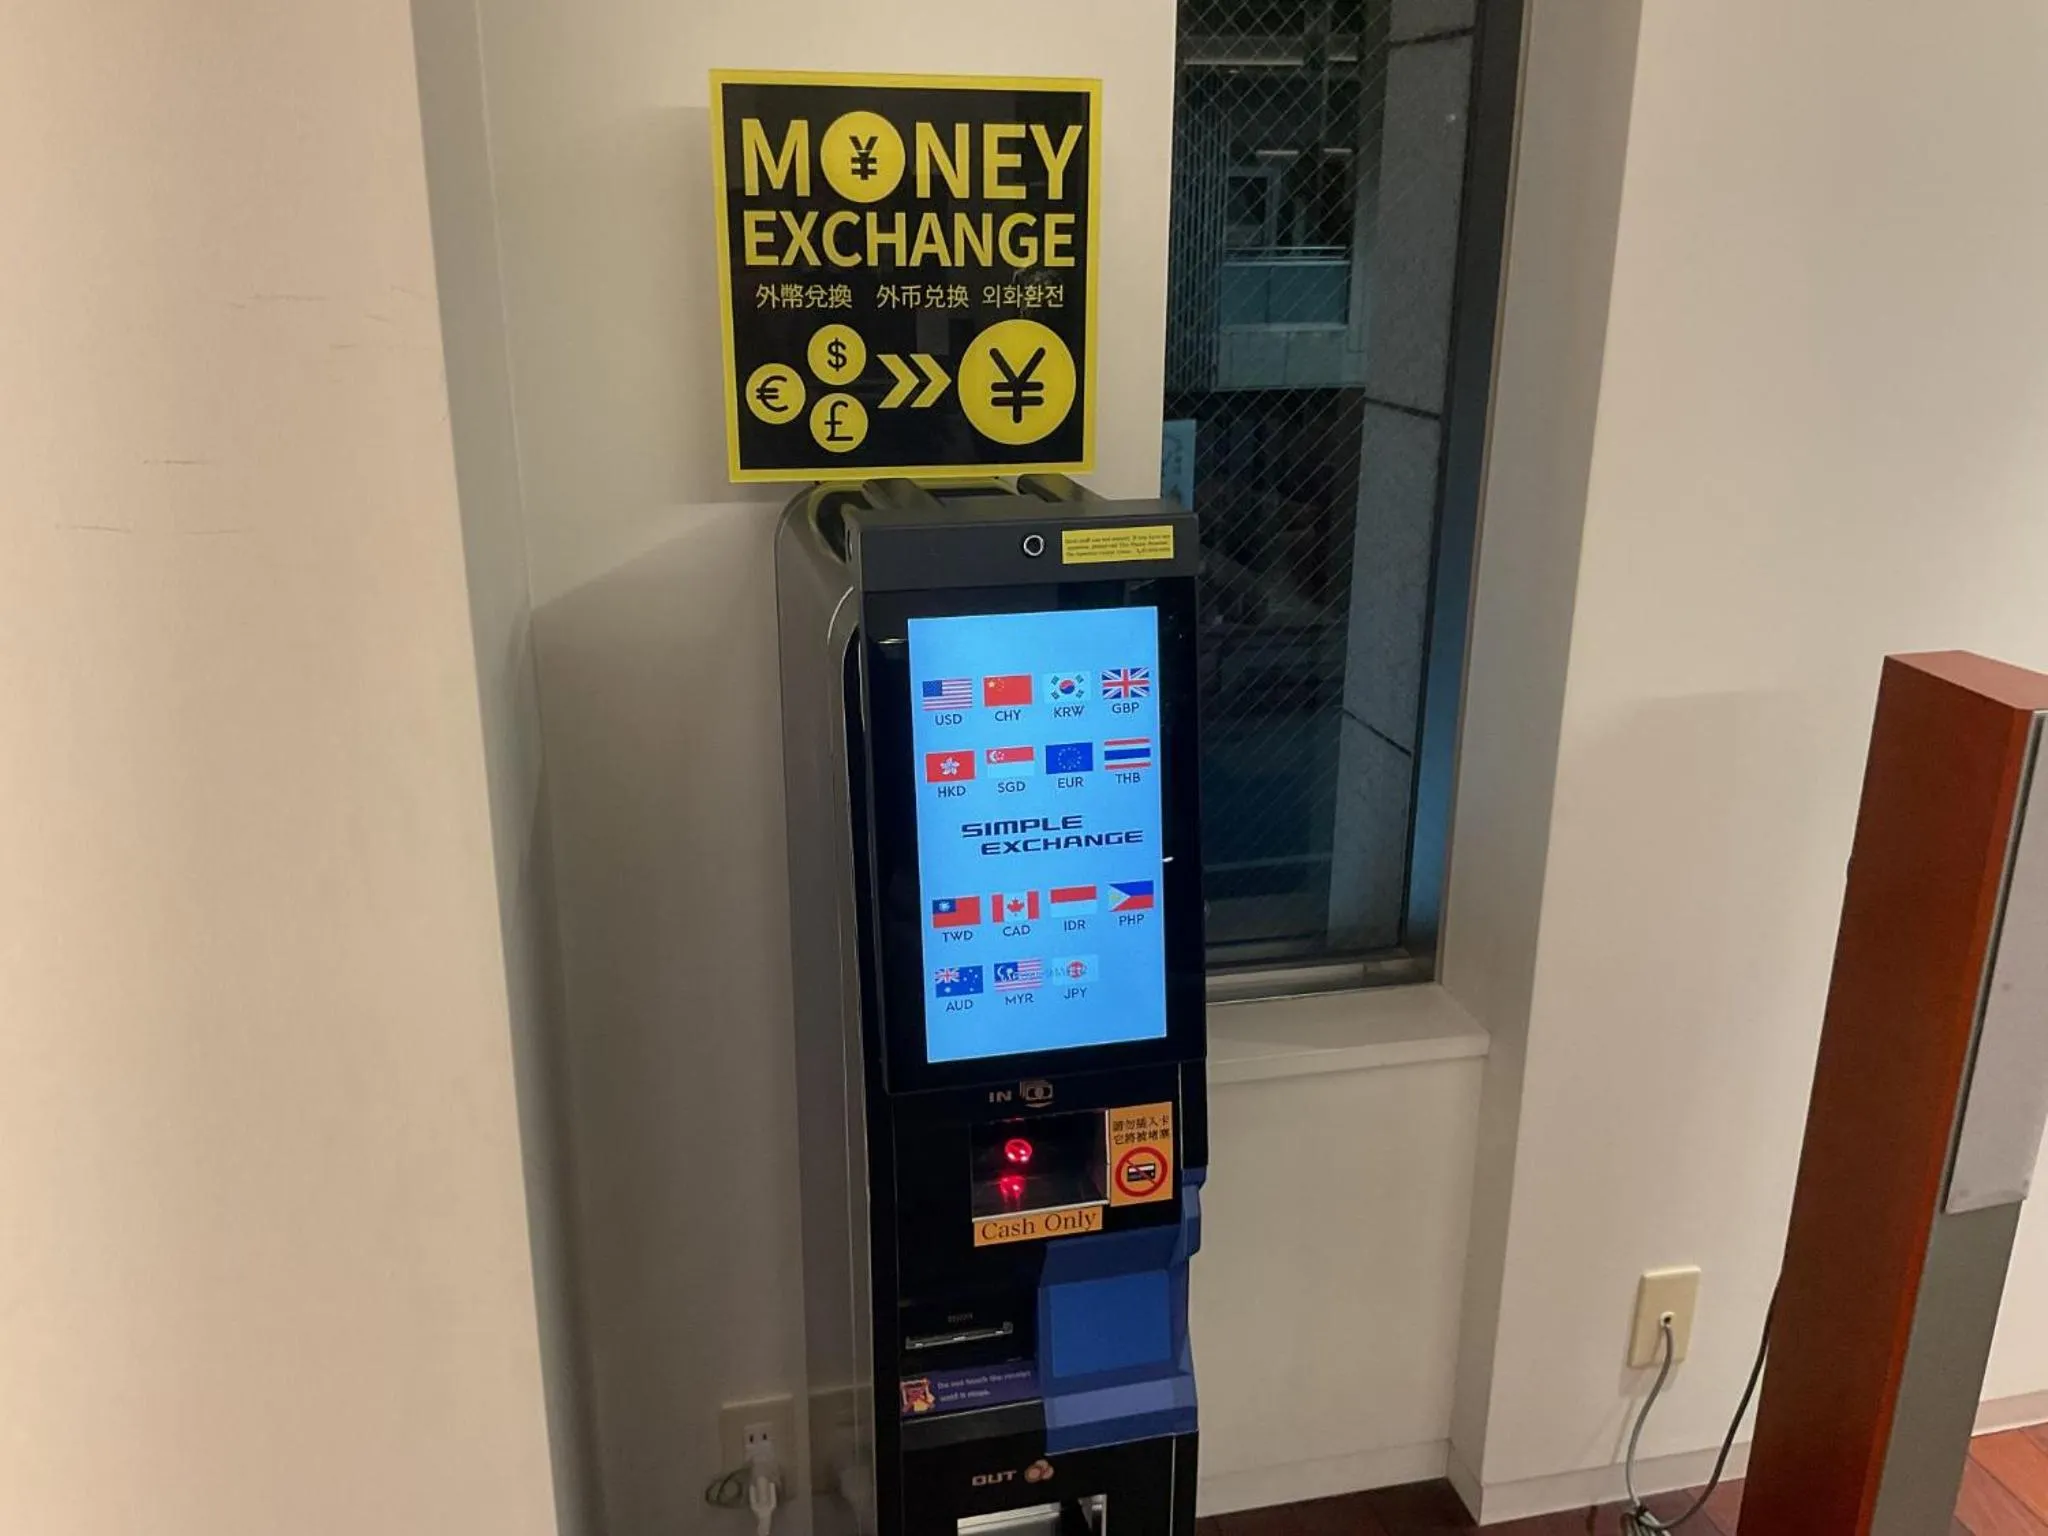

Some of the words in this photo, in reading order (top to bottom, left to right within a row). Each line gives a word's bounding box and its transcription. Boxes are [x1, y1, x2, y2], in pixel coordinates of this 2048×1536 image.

[743, 209, 1076, 268] EXCHANGE
[876, 284, 970, 309] 外币兑换
[982, 285, 1065, 309] 외화환전
[1054, 705, 1085, 718] KRW
[1112, 702, 1139, 714] GBP
[935, 713, 962, 726] USD
[994, 710, 1021, 722] CHY
[1058, 777, 1084, 789] EUR
[1116, 773, 1141, 784] THB
[938, 785, 966, 798] HKD
[997, 781, 1025, 793] SGD
[962, 815, 1083, 838] SIMPLE
[981, 830, 1144, 855] EXCHANGE
[1064, 919, 1087, 932] IDR
[1119, 914, 1145, 926] PHP
[942, 931, 973, 942] TWD
[1002, 925, 1031, 937] CAD
[1005, 993, 1034, 1006] MYR
[1064, 988, 1088, 1000] JPY
[946, 1000, 973, 1012] AUD
[989, 1090, 1012, 1103] IN
[982, 1218, 1035, 1241] Cash
[1045, 1210, 1097, 1231] Only
[971, 1469, 1017, 1487] OUT
